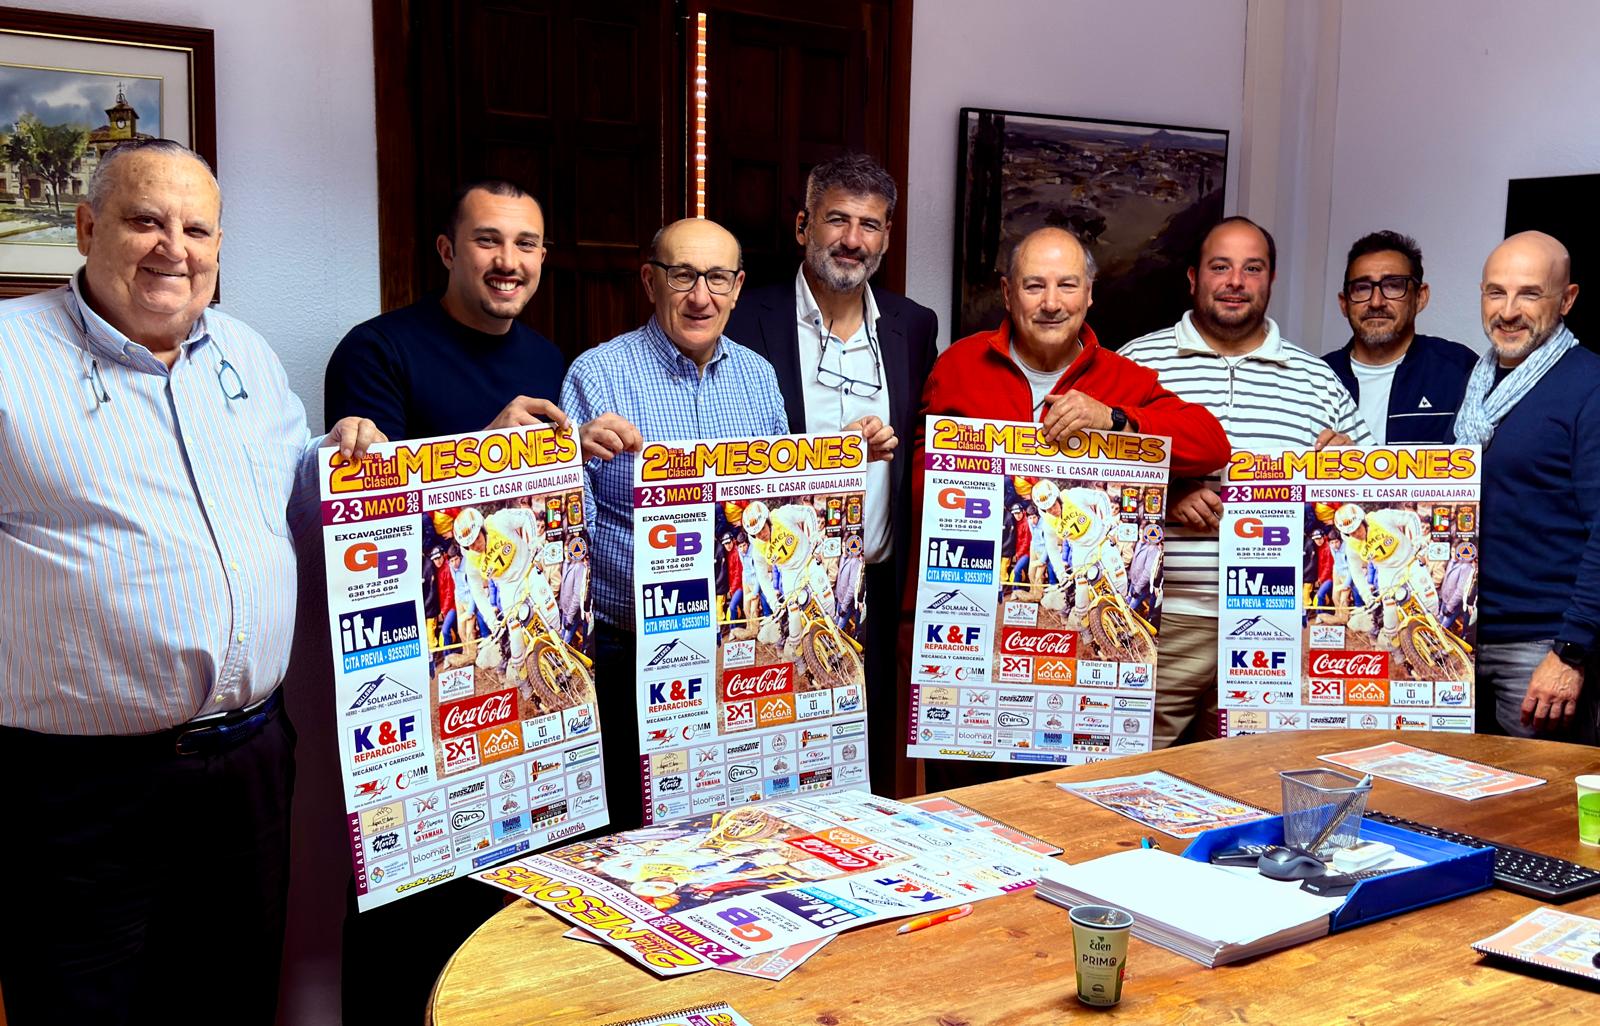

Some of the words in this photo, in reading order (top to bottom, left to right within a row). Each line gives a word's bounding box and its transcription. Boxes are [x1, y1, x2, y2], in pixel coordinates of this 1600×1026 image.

[934, 419, 959, 450] 2
[959, 426, 984, 443] Trial
[958, 440, 985, 451] Clásico
[395, 425, 578, 486] MESONES
[641, 444, 667, 481] 2
[667, 452, 695, 468] Trial
[695, 436, 862, 477] MESONES
[956, 457, 991, 471] MAYO
[327, 449, 364, 494] 2
[361, 456, 396, 477] Trial
[667, 465, 697, 478] Clásico
[1056, 465, 1066, 474] EL
[1069, 465, 1098, 477] CASAR
[1228, 451, 1256, 481] 2
[1255, 458, 1283, 472] Trial
[1283, 449, 1477, 480] MESONES
[363, 472, 400, 489] Clásico
[479, 485, 490, 497] EL
[492, 480, 522, 495] CASAR
[524, 472, 579, 490] (GUADALAJARA)
[702, 483, 713, 493] 20
[767, 483, 776, 493] EL
[779, 481, 806, 492] CASAR
[808, 477, 861, 490] (GUADALAJARA)
[931, 477, 996, 487] EXCAVACIONES
[405, 491, 419, 503] 20
[667, 486, 701, 502] MAYO
[701, 492, 713, 501] 26
[1253, 487, 1290, 499] MAYO
[1363, 489, 1373, 497] EL
[1376, 488, 1408, 497] CASAR
[364, 496, 406, 517] MAYO
[406, 502, 419, 513] 26
[938, 487, 991, 519] GB
[642, 511, 707, 522] EXCAVACIONES
[334, 523, 413, 542] EXCAVACIONES
[1068, 522, 1077, 532] 7
[1234, 517, 1289, 546] GB
[373, 532, 401, 541] GARBER
[648, 521, 702, 559] GB
[777, 544, 786, 556] 7
[929, 539, 964, 567] itv
[961, 558, 970, 568] EL
[971, 558, 992, 569] CASAR
[1374, 544, 1384, 554] 7
[342, 536, 408, 584] GB
[494, 554, 504, 568] 7
[927, 570, 941, 580] CITA
[941, 570, 961, 581] PREVIA
[1229, 568, 1263, 594] itv
[1261, 585, 1270, 594] EL
[1271, 584, 1294, 595] CASAR
[347, 583, 363, 591] 636
[365, 580, 381, 588] 732
[366, 587, 383, 595] 154
[644, 583, 679, 617] itv
[677, 601, 686, 613] EL
[686, 599, 708, 612] CASAR
[1228, 598, 1241, 607] CITA
[1242, 598, 1262, 607] PREVIA
[341, 609, 384, 652] itv
[381, 630, 392, 644] EL
[392, 624, 418, 642] CASAR
[645, 620, 658, 633] CITA
[659, 618, 678, 631] PREVIA
[681, 614, 709, 628] 925530719
[926, 624, 943, 642] K
[946, 624, 964, 643] &
[964, 626, 980, 645] F
[1004, 629, 1073, 654] Coca-Cola
[344, 655, 360, 671] CITA
[360, 649, 384, 667] PREVIA
[387, 641, 419, 661] 925530719
[923, 643, 978, 652] REPARACIONES
[662, 655, 688, 665] SOLMAN
[1231, 650, 1248, 668] K
[1251, 650, 1269, 668] &
[1271, 651, 1285, 669] F
[1312, 653, 1384, 674] Coca-Cola
[726, 666, 790, 697] Coca-Cola
[1037, 670, 1072, 678] MOLGAR
[366, 692, 397, 706] SOLMAN
[399, 688, 411, 698] S.L.
[650, 681, 666, 704] K
[669, 678, 686, 701] &
[688, 677, 702, 699] F
[798, 689, 826, 699] Talleres
[442, 691, 515, 734] Coca-Cola
[648, 698, 702, 712] REPARACIONES
[760, 707, 791, 719] MOLGAR
[799, 708, 829, 718] Llorente
[524, 713, 556, 728] Talleres
[646, 714, 672, 724] MECÁNICA
[677, 708, 708, 718] CARROCERÍA
[910, 688, 920, 741] COLABORAN
[354, 724, 375, 753] K
[377, 718, 398, 746] &
[398, 714, 416, 742] F
[527, 733, 560, 748] Llorente
[354, 739, 417, 763] REPARACIONES
[484, 737, 519, 754] MOLGAR
[352, 762, 382, 777] MECÁNICA
[389, 750, 425, 766] CARROCERÍA
[447, 755, 476, 766] SHOCKS
[642, 759, 652, 820] COLABORAN
[701, 778, 720, 786] YAMAHA
[421, 827, 443, 840] YAMAHA
[547, 831, 556, 840] LA
[556, 819, 585, 837] CAMPIÑA
[351, 817, 366, 889] COLABORAN
[873, 878, 904, 886] F
[894, 883, 920, 893] &
[483, 866, 652, 941] MESONES
[910, 891, 943, 902] K
[716, 907, 773, 943] GB
[662, 925, 703, 946] MAYO
[643, 948, 704, 968] 2
